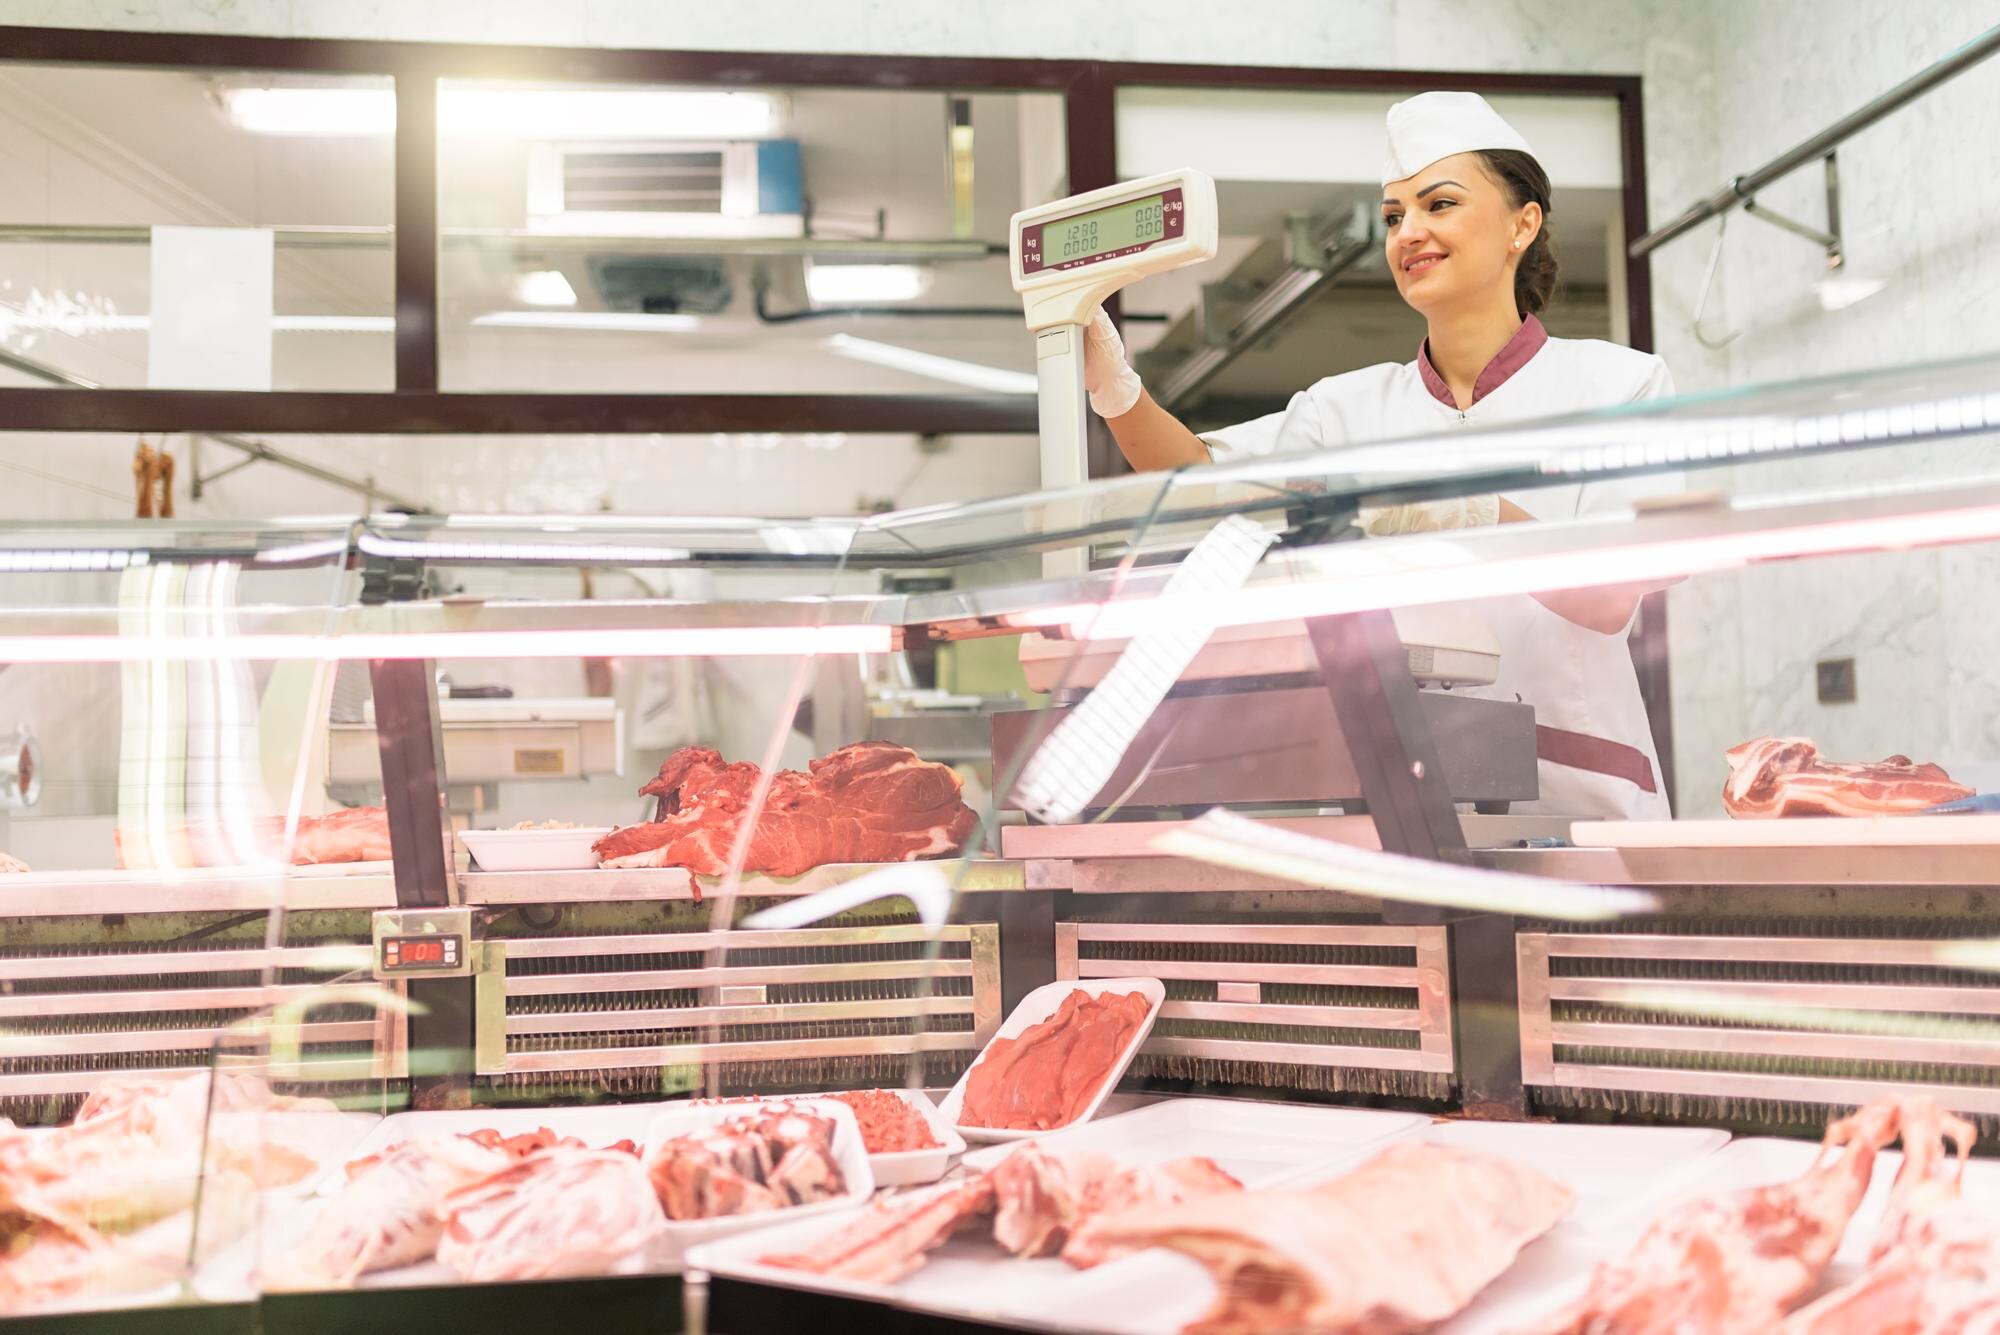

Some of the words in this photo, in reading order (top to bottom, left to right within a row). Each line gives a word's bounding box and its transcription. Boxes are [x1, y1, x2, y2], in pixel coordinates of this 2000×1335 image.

[1164, 201, 1182, 212] €/kg
[1170, 217, 1177, 227] €
[1027, 238, 1037, 248] kg
[1023, 254, 1030, 264] T
[1031, 253, 1041, 263] kg
[414, 943, 428, 961] 0
